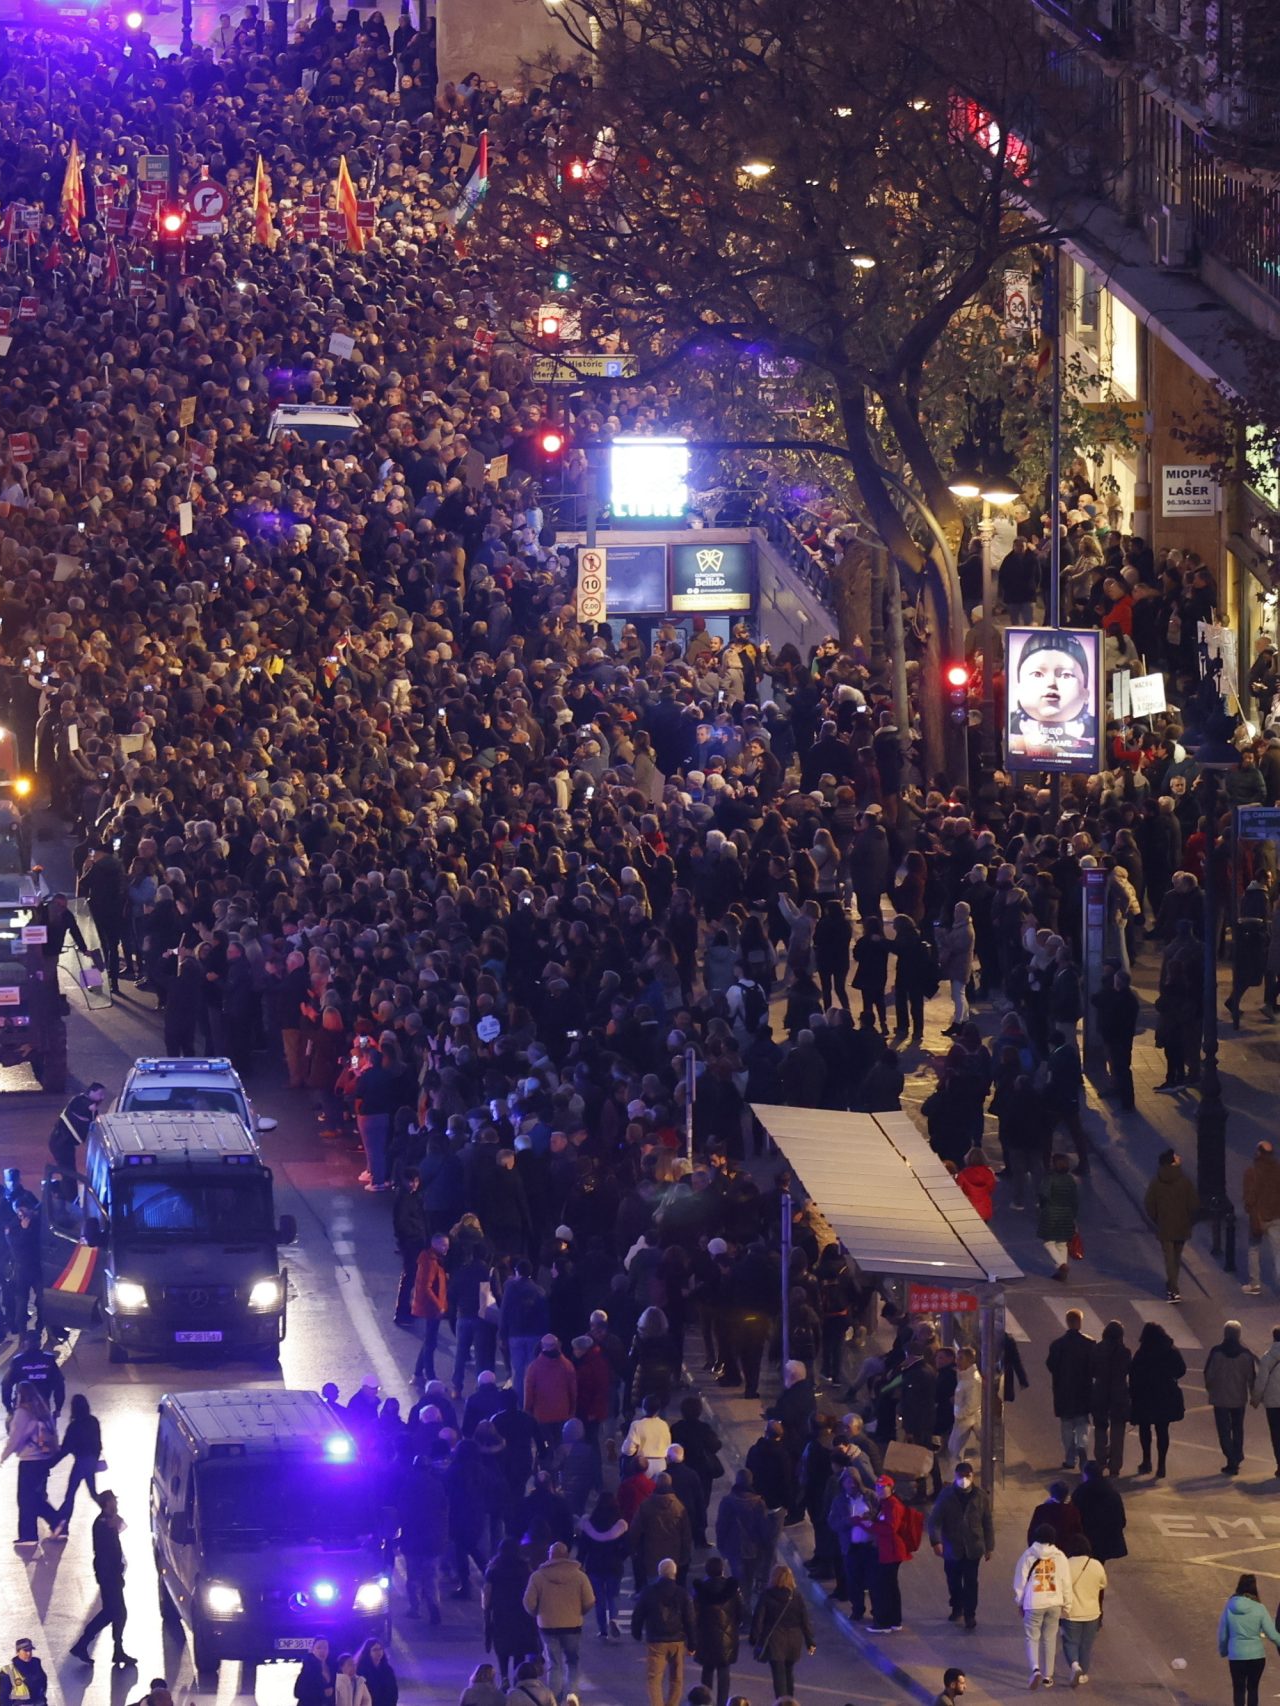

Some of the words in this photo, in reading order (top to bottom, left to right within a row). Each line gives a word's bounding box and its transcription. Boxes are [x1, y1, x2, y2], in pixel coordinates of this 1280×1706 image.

[608, 363, 618, 375] P
[1165, 469, 1211, 479] MIOPIA
[1168, 486, 1209, 496] LASER
[584, 579, 598, 589] 10
[694, 577, 726, 587] Bellido
[1150, 1514, 1280, 1540] EM
